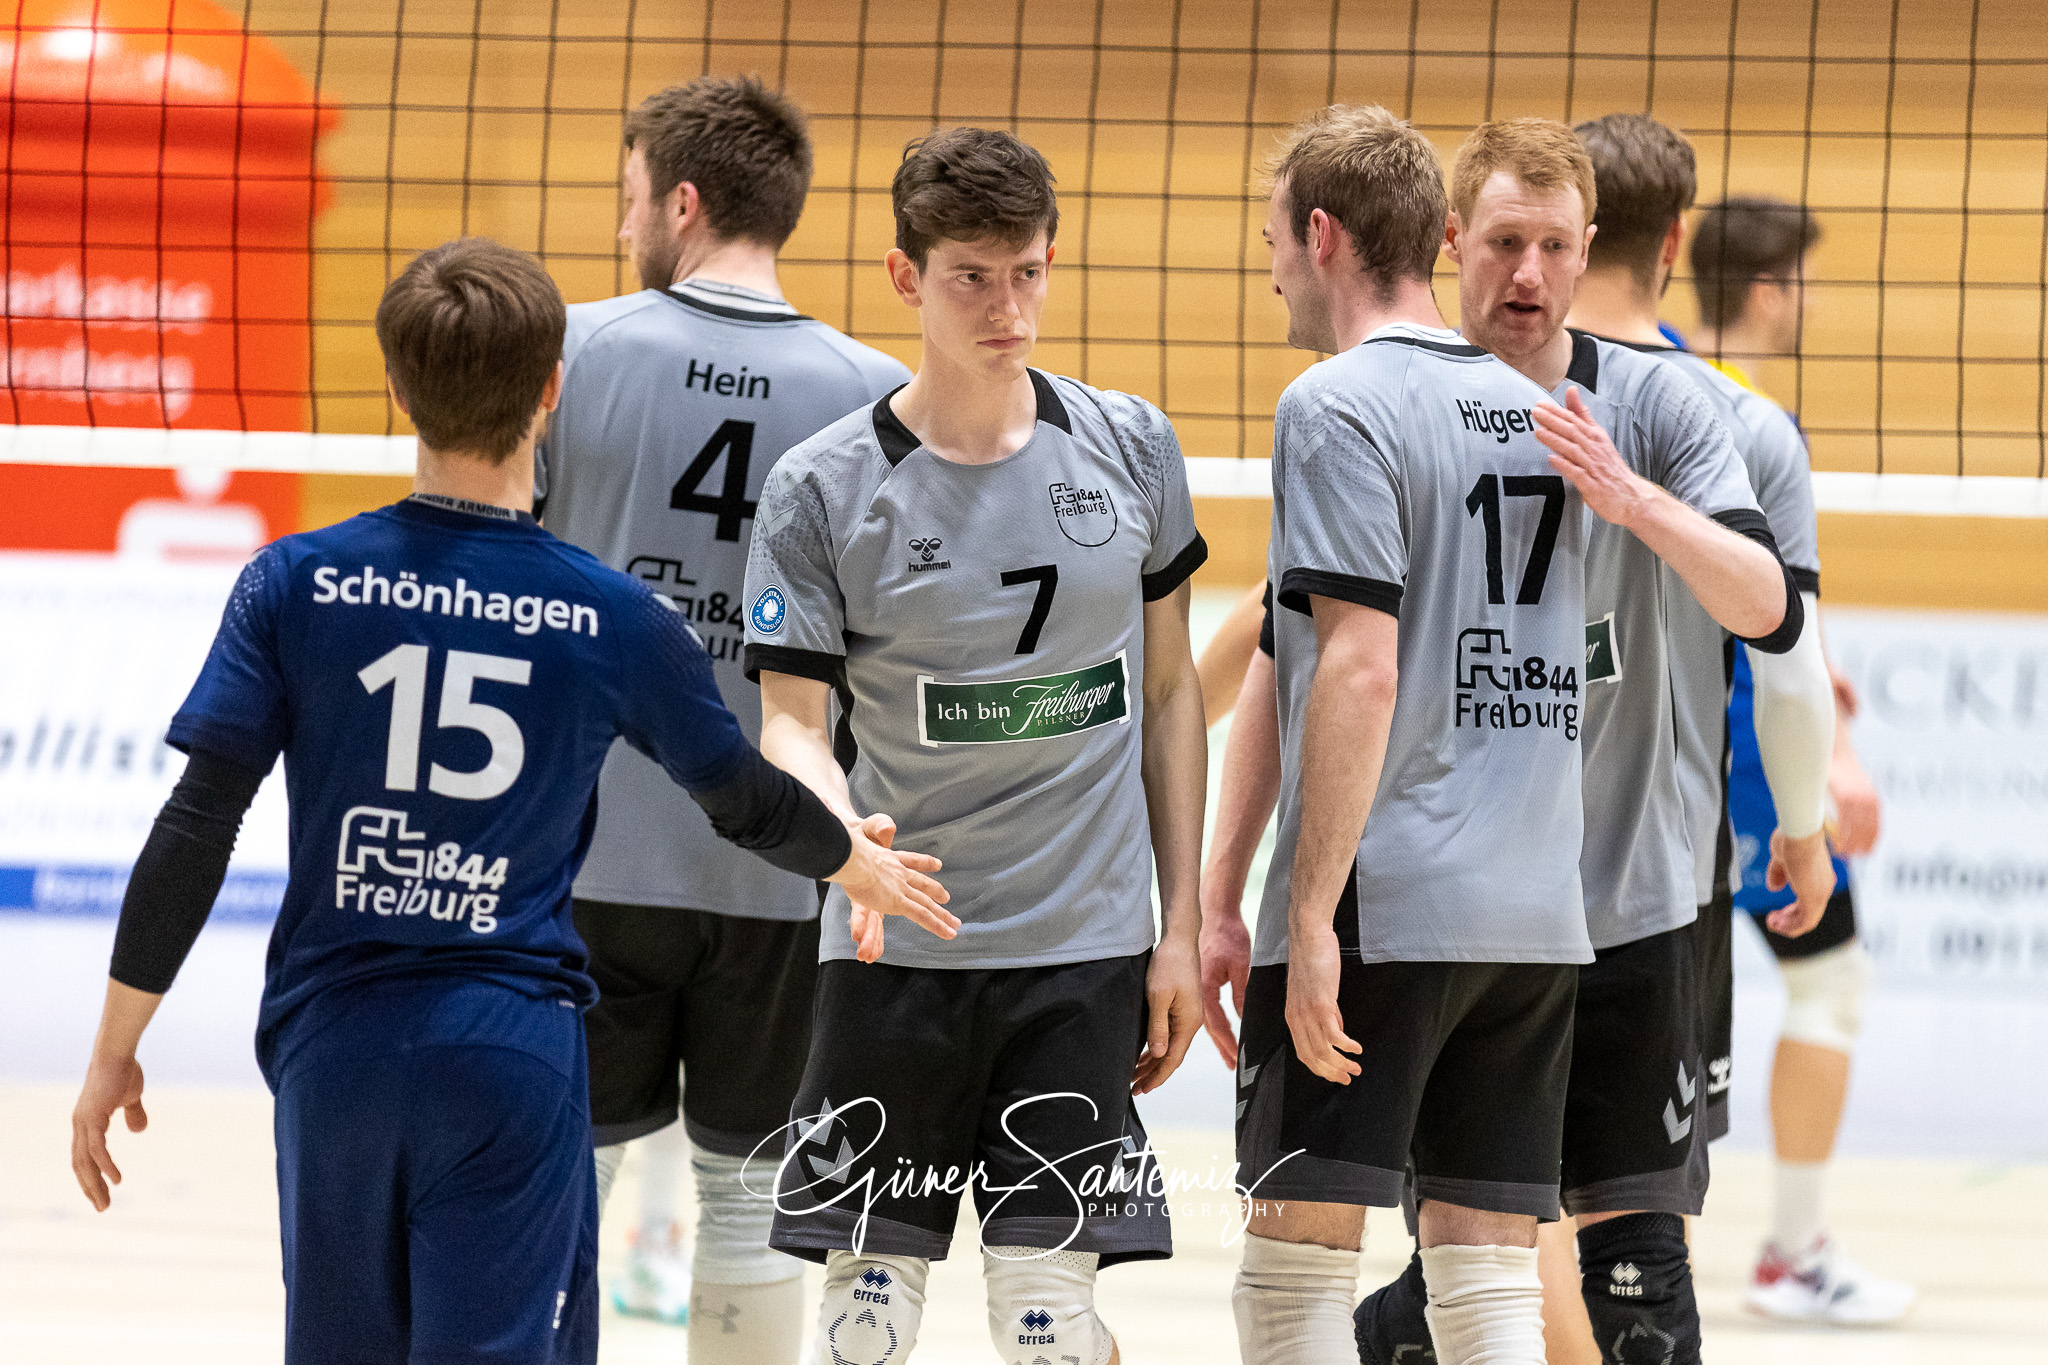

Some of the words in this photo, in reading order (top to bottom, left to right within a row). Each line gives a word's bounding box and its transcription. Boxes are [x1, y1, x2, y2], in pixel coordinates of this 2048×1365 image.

[685, 359, 771, 399] Hein
[669, 418, 756, 543] 4
[1076, 489, 1103, 501] 1844
[458, 500, 510, 517] ARMOUR
[1053, 501, 1108, 518] Freiburg
[1465, 473, 1566, 605] 17
[908, 559, 951, 573] hummel
[313, 566, 599, 637] Schönhagen
[697, 590, 744, 632] 184
[754, 615, 783, 630] BUNDESLIGA
[1000, 563, 1059, 655] 7
[1512, 656, 1578, 698] 1844
[357, 643, 533, 800] 15
[937, 703, 968, 720] Ich
[977, 702, 1011, 720] bin
[1002, 680, 1115, 736] Freiburger
[1036, 711, 1086, 727] PILSNER
[1455, 692, 1578, 741] Freiburg
[426, 842, 509, 891] 1844
[336, 872, 500, 934] Freiburg
